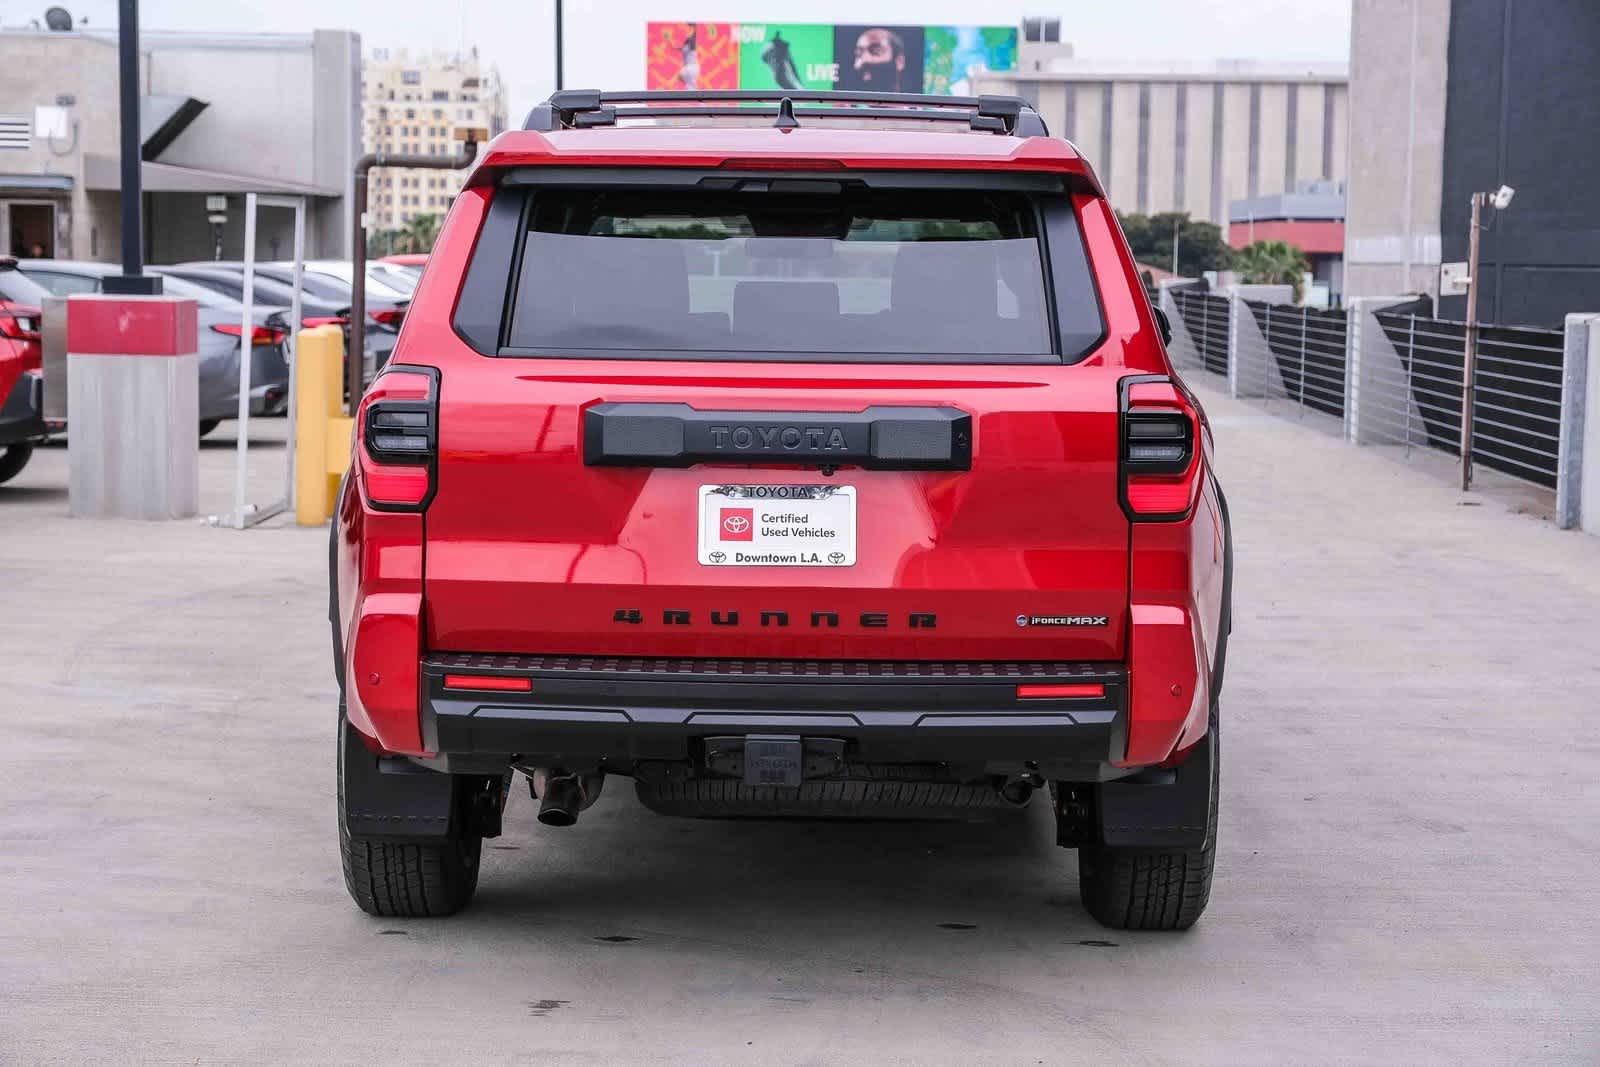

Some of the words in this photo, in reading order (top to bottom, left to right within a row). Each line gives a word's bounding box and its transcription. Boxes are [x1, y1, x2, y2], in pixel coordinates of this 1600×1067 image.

[806, 64, 840, 82] LIVE
[710, 426, 849, 451] TOYOTA
[749, 486, 809, 498] TOYOTA
[761, 513, 809, 524] Certified
[761, 527, 789, 537] Used
[791, 527, 836, 538] Vehicles
[735, 552, 797, 563] Downtown
[800, 553, 823, 563] L.A.
